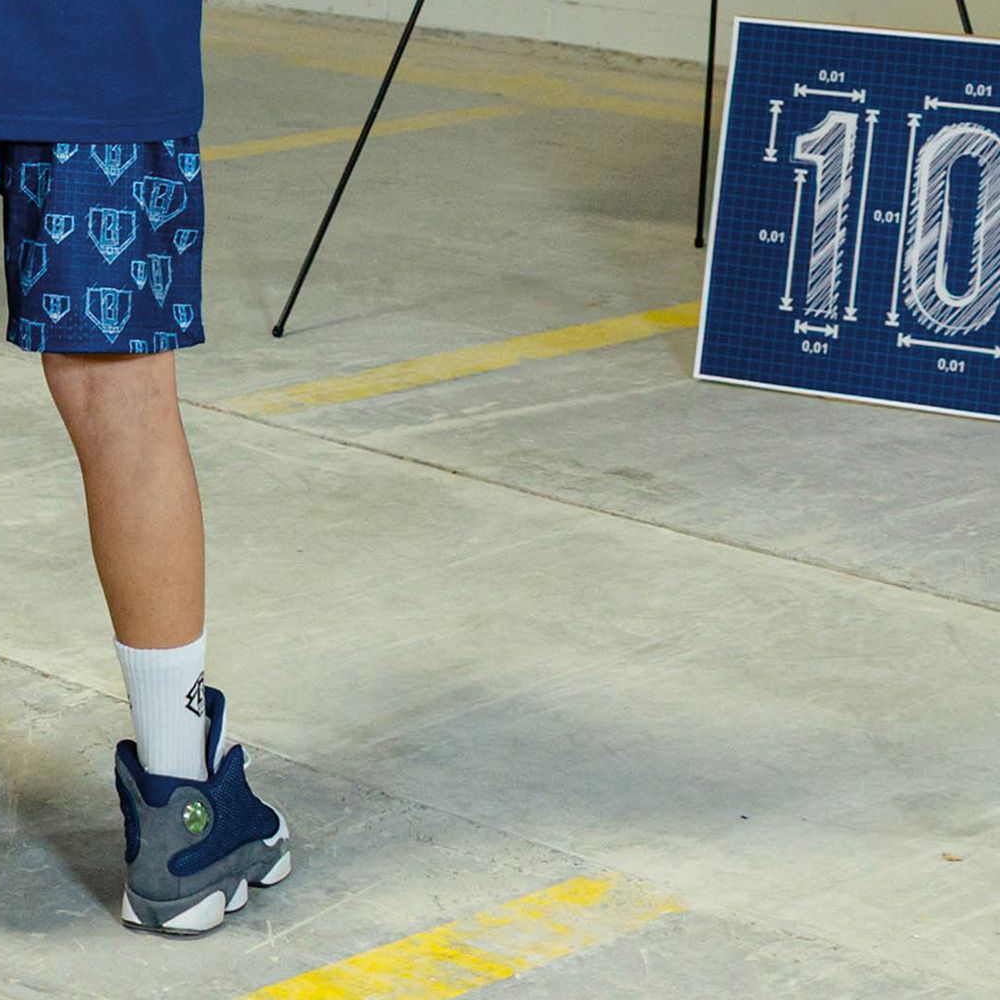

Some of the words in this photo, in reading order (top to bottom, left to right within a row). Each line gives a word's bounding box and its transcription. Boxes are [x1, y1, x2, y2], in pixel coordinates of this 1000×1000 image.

[818, 69, 846, 83] 0,01
[965, 83, 992, 97] 0,01
[873, 209, 901, 224] 0,01
[758, 229, 785, 243] 0,01
[801, 341, 829, 355] 0,01
[937, 358, 966, 373] 0,01
